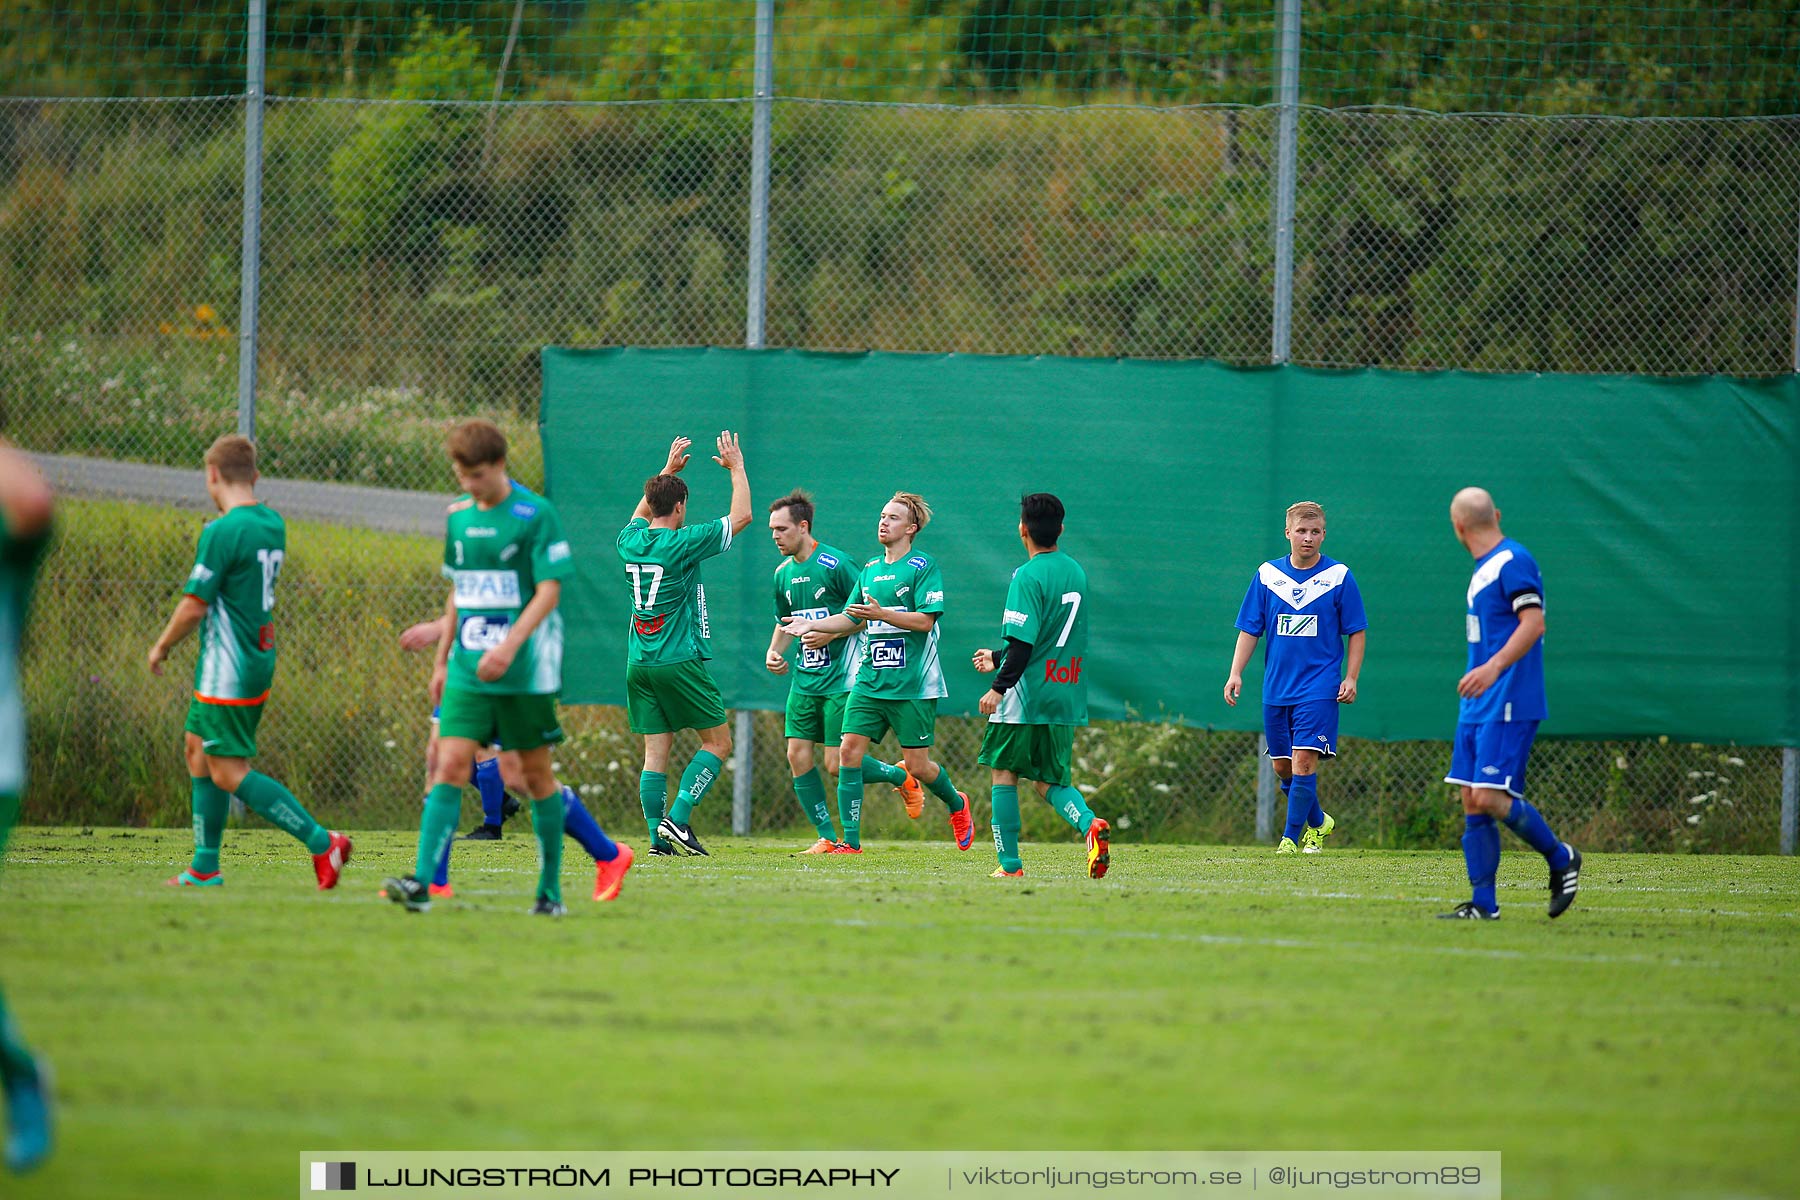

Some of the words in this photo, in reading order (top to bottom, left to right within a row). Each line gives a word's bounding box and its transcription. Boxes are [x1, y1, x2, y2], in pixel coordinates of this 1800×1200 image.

[626, 563, 664, 611] 17
[1055, 591, 1082, 648] 7
[1045, 656, 1083, 684] Rolf
[689, 767, 714, 800] stadium
